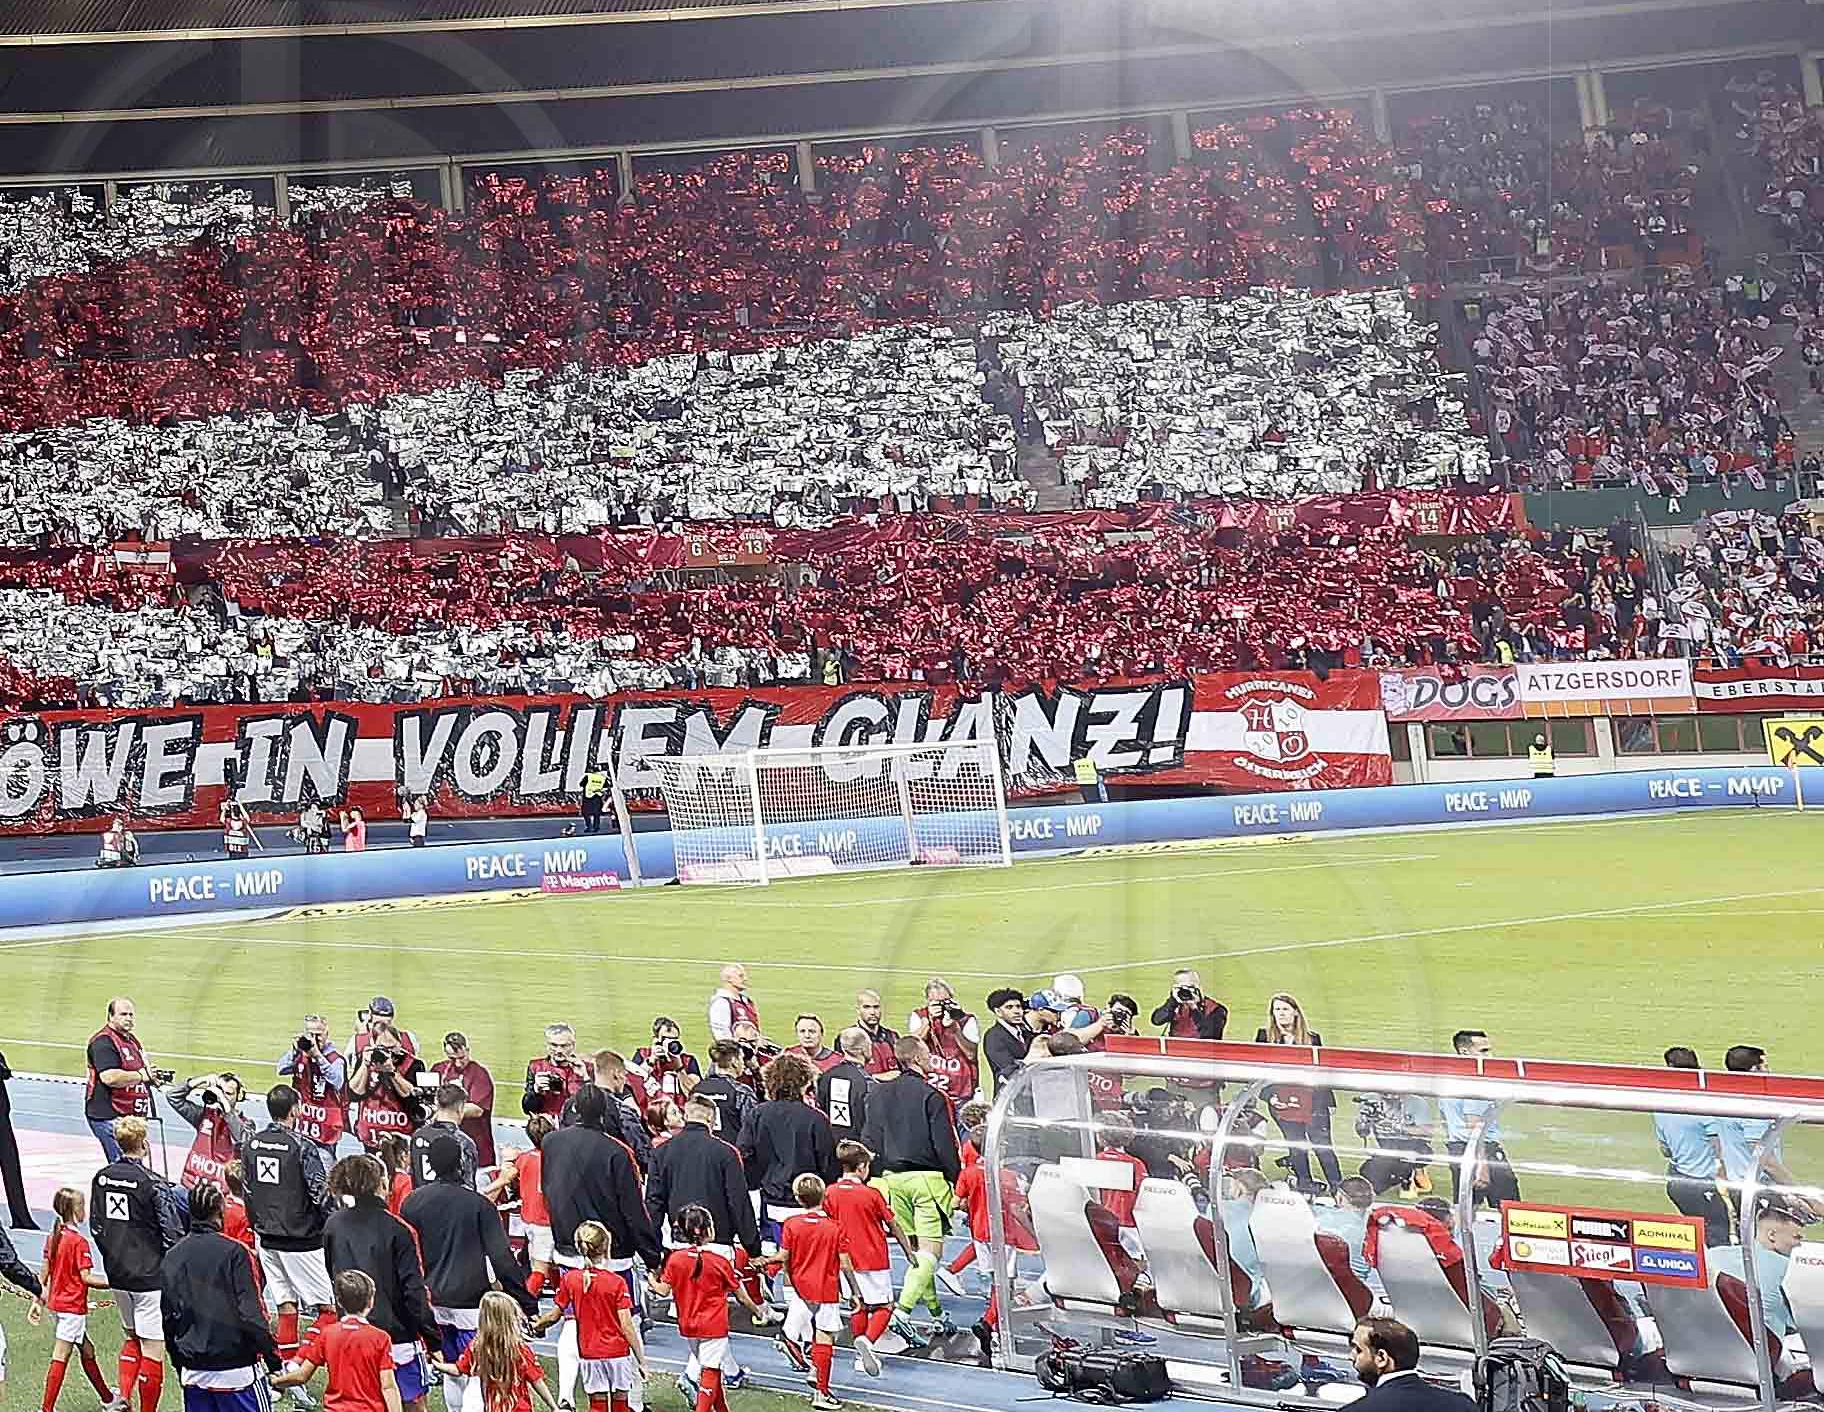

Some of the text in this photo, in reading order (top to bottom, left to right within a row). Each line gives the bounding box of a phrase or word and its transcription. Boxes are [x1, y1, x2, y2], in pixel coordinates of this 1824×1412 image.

[745, 540, 763, 554] 13
[1528, 670, 1683, 691] ATZGERSDORF
[1713, 679, 1824, 697] EBERSTA
[1412, 676, 1518, 709] DOGS
[237, 717, 349, 805] IN
[396, 698, 780, 796] VOLLEM
[817, 686, 1190, 786] GLANZ!
[1649, 778, 1701, 798] PEACE
[1446, 792, 1489, 812] PEACE
[1500, 790, 1531, 808] МИР
[1234, 804, 1280, 825] PEACE
[1290, 801, 1322, 821] МИР
[1067, 815, 1102, 835] МИР
[467, 852, 526, 879] PEACE
[545, 849, 587, 873] МИР
[150, 877, 214, 902] PEACE
[235, 870, 283, 895] МИР
[559, 872, 618, 889] Magenta
[361, 1108, 408, 1126] PHOTO
[191, 1154, 225, 1176] PHOT
